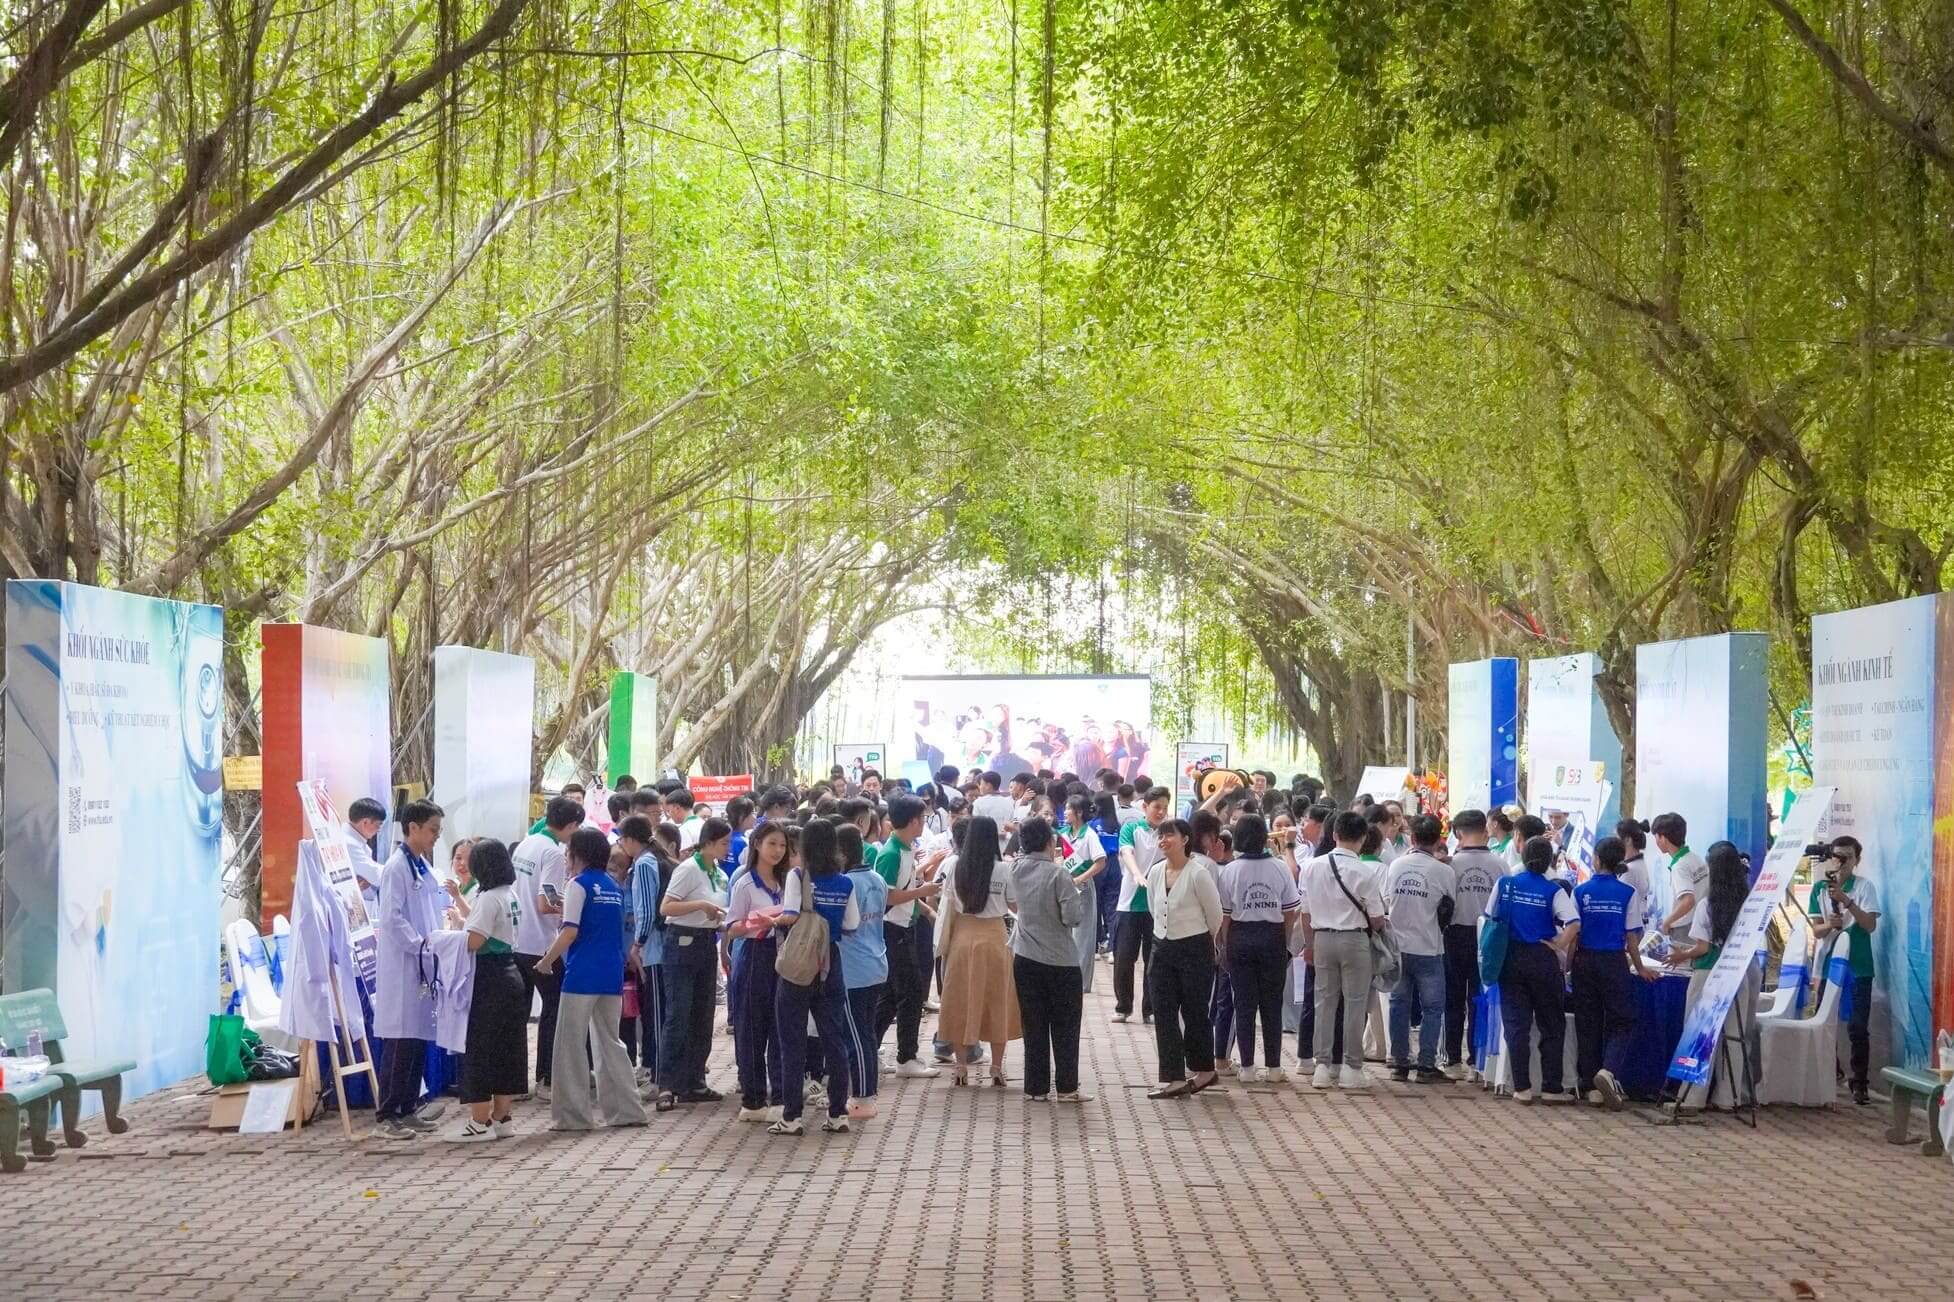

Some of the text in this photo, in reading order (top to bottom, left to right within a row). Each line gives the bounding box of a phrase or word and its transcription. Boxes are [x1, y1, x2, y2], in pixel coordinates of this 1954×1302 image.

[89, 632, 113, 661] NGÀNH
[1837, 656, 1861, 683] NGÀNH
[1863, 657, 1881, 681] KINH
[1407, 888, 1428, 898] NINH
[1254, 901, 1277, 909] NINH
